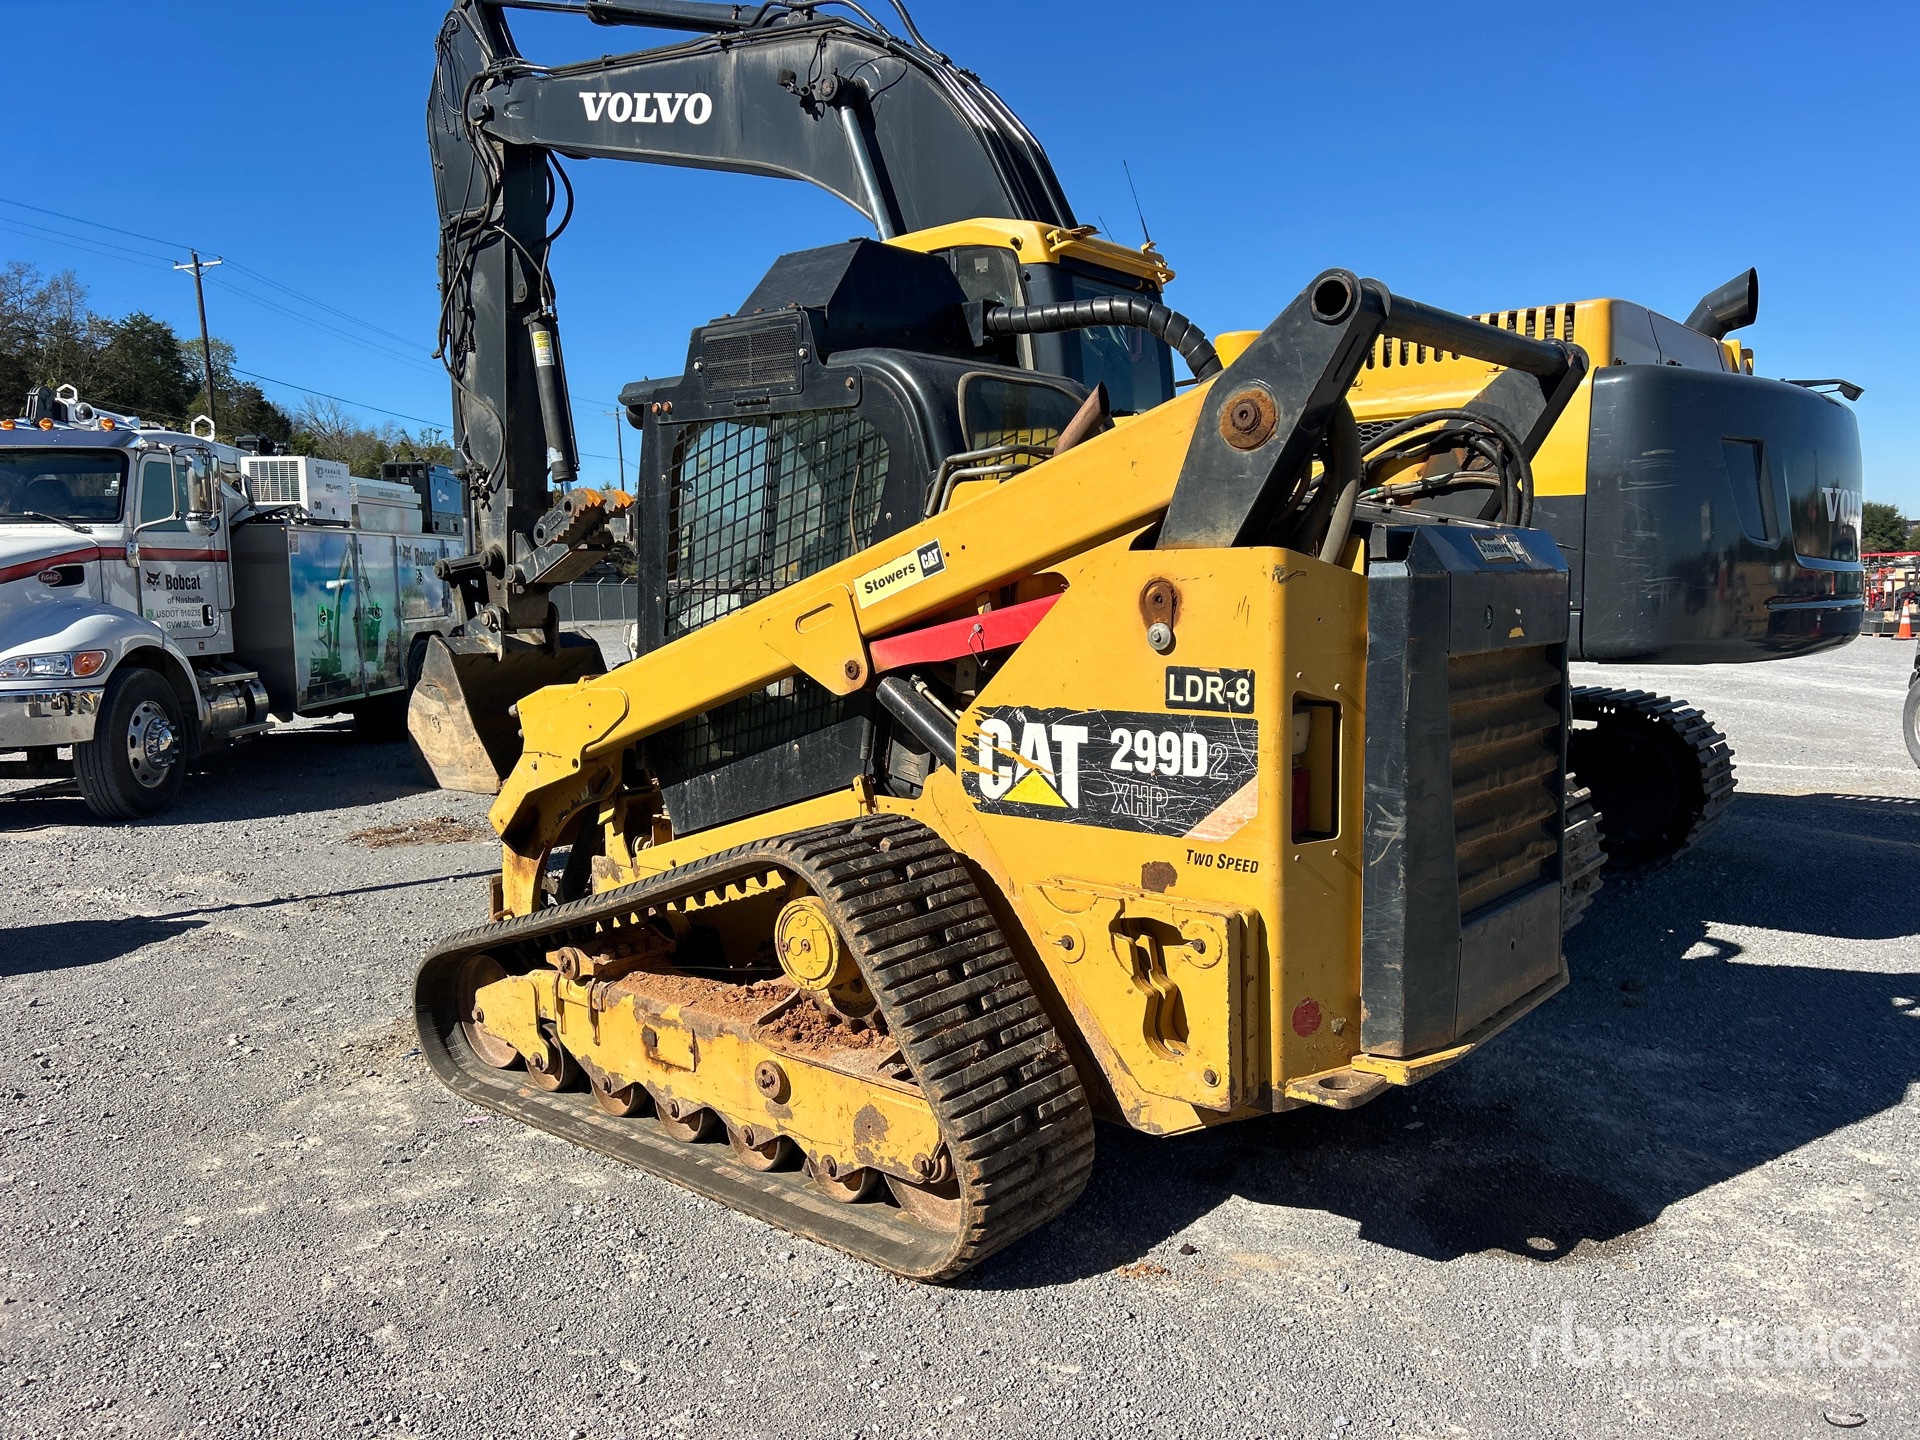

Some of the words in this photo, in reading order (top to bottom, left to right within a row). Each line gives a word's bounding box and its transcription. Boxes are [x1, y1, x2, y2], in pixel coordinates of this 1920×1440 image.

[578, 91, 713, 125] VOLVO
[164, 574, 201, 591] Bobcat
[864, 562, 916, 595] Stowers
[920, 547, 940, 570] CAT
[156, 610, 179, 619] USDOT
[167, 596, 174, 605] of
[175, 595, 205, 604] Nashville
[166, 620, 182, 629] GVW
[1168, 673, 1250, 707] LDR-8
[977, 718, 1089, 809] CAT
[1110, 781, 1170, 819] XHP
